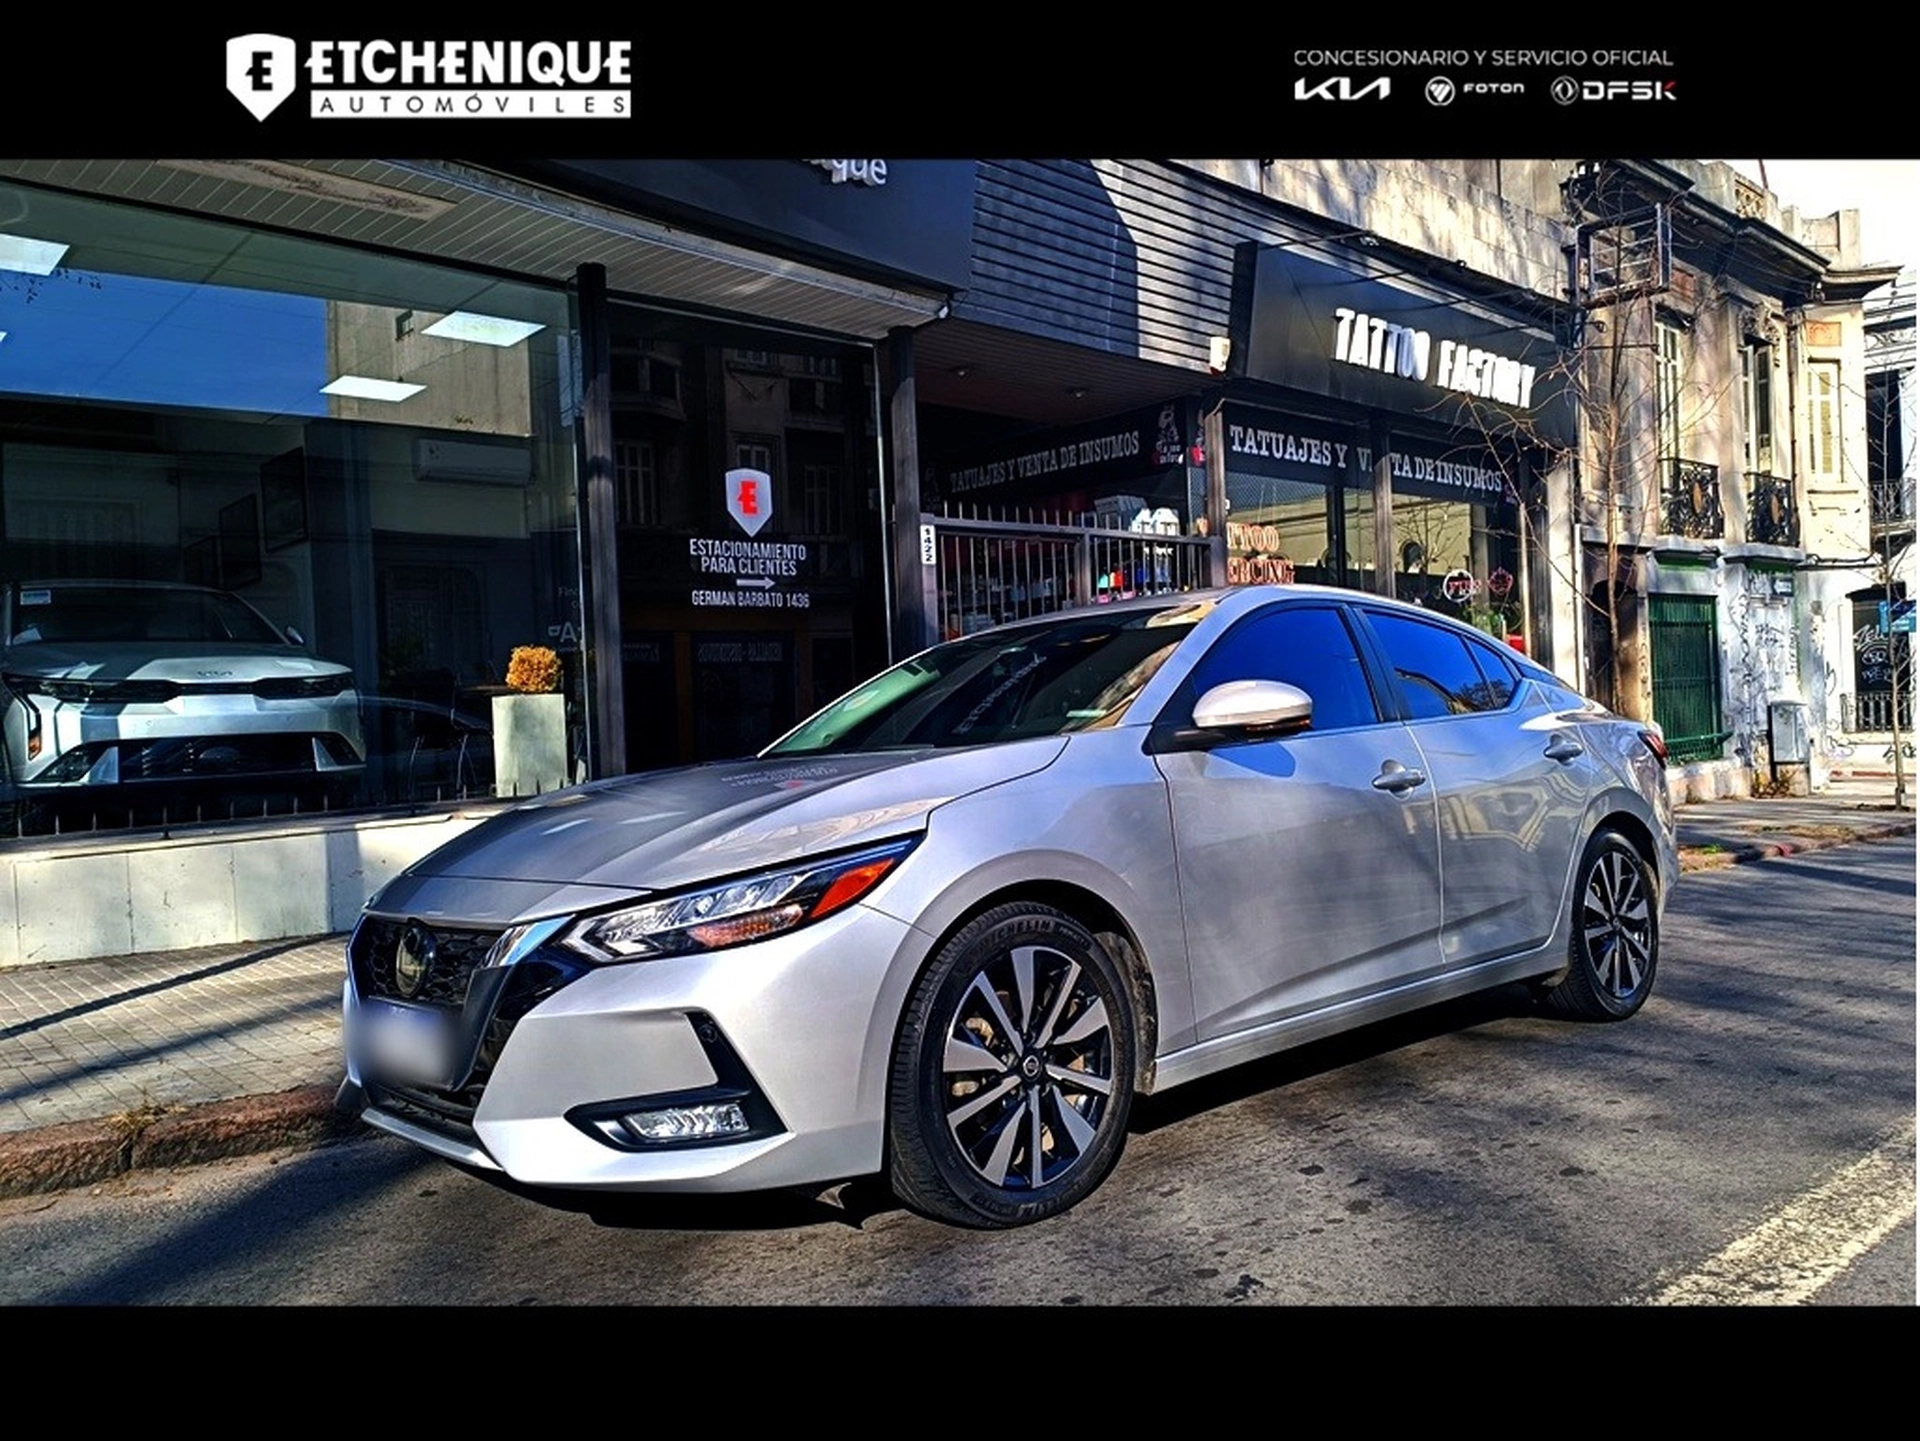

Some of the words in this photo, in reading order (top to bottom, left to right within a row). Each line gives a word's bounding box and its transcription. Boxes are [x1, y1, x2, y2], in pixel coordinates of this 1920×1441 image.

[1336, 309, 1430, 381] TATTOO
[1005, 457, 1015, 481] Y
[1017, 449, 1059, 478] VENTA
[1060, 444, 1077, 470] DE
[1079, 430, 1140, 465] INSUMOS
[1229, 425, 1332, 466] TATUAJES
[1335, 443, 1348, 468] Y
[1414, 456, 1435, 481] DE
[1436, 460, 1502, 492] INSUMOS
[690, 538, 806, 560] ESTACIONAMIENTO
[701, 556, 736, 574] PARA
[739, 557, 797, 575] CLIENTES
[692, 589, 736, 606] GERMAN
[737, 591, 783, 607] BARBATO
